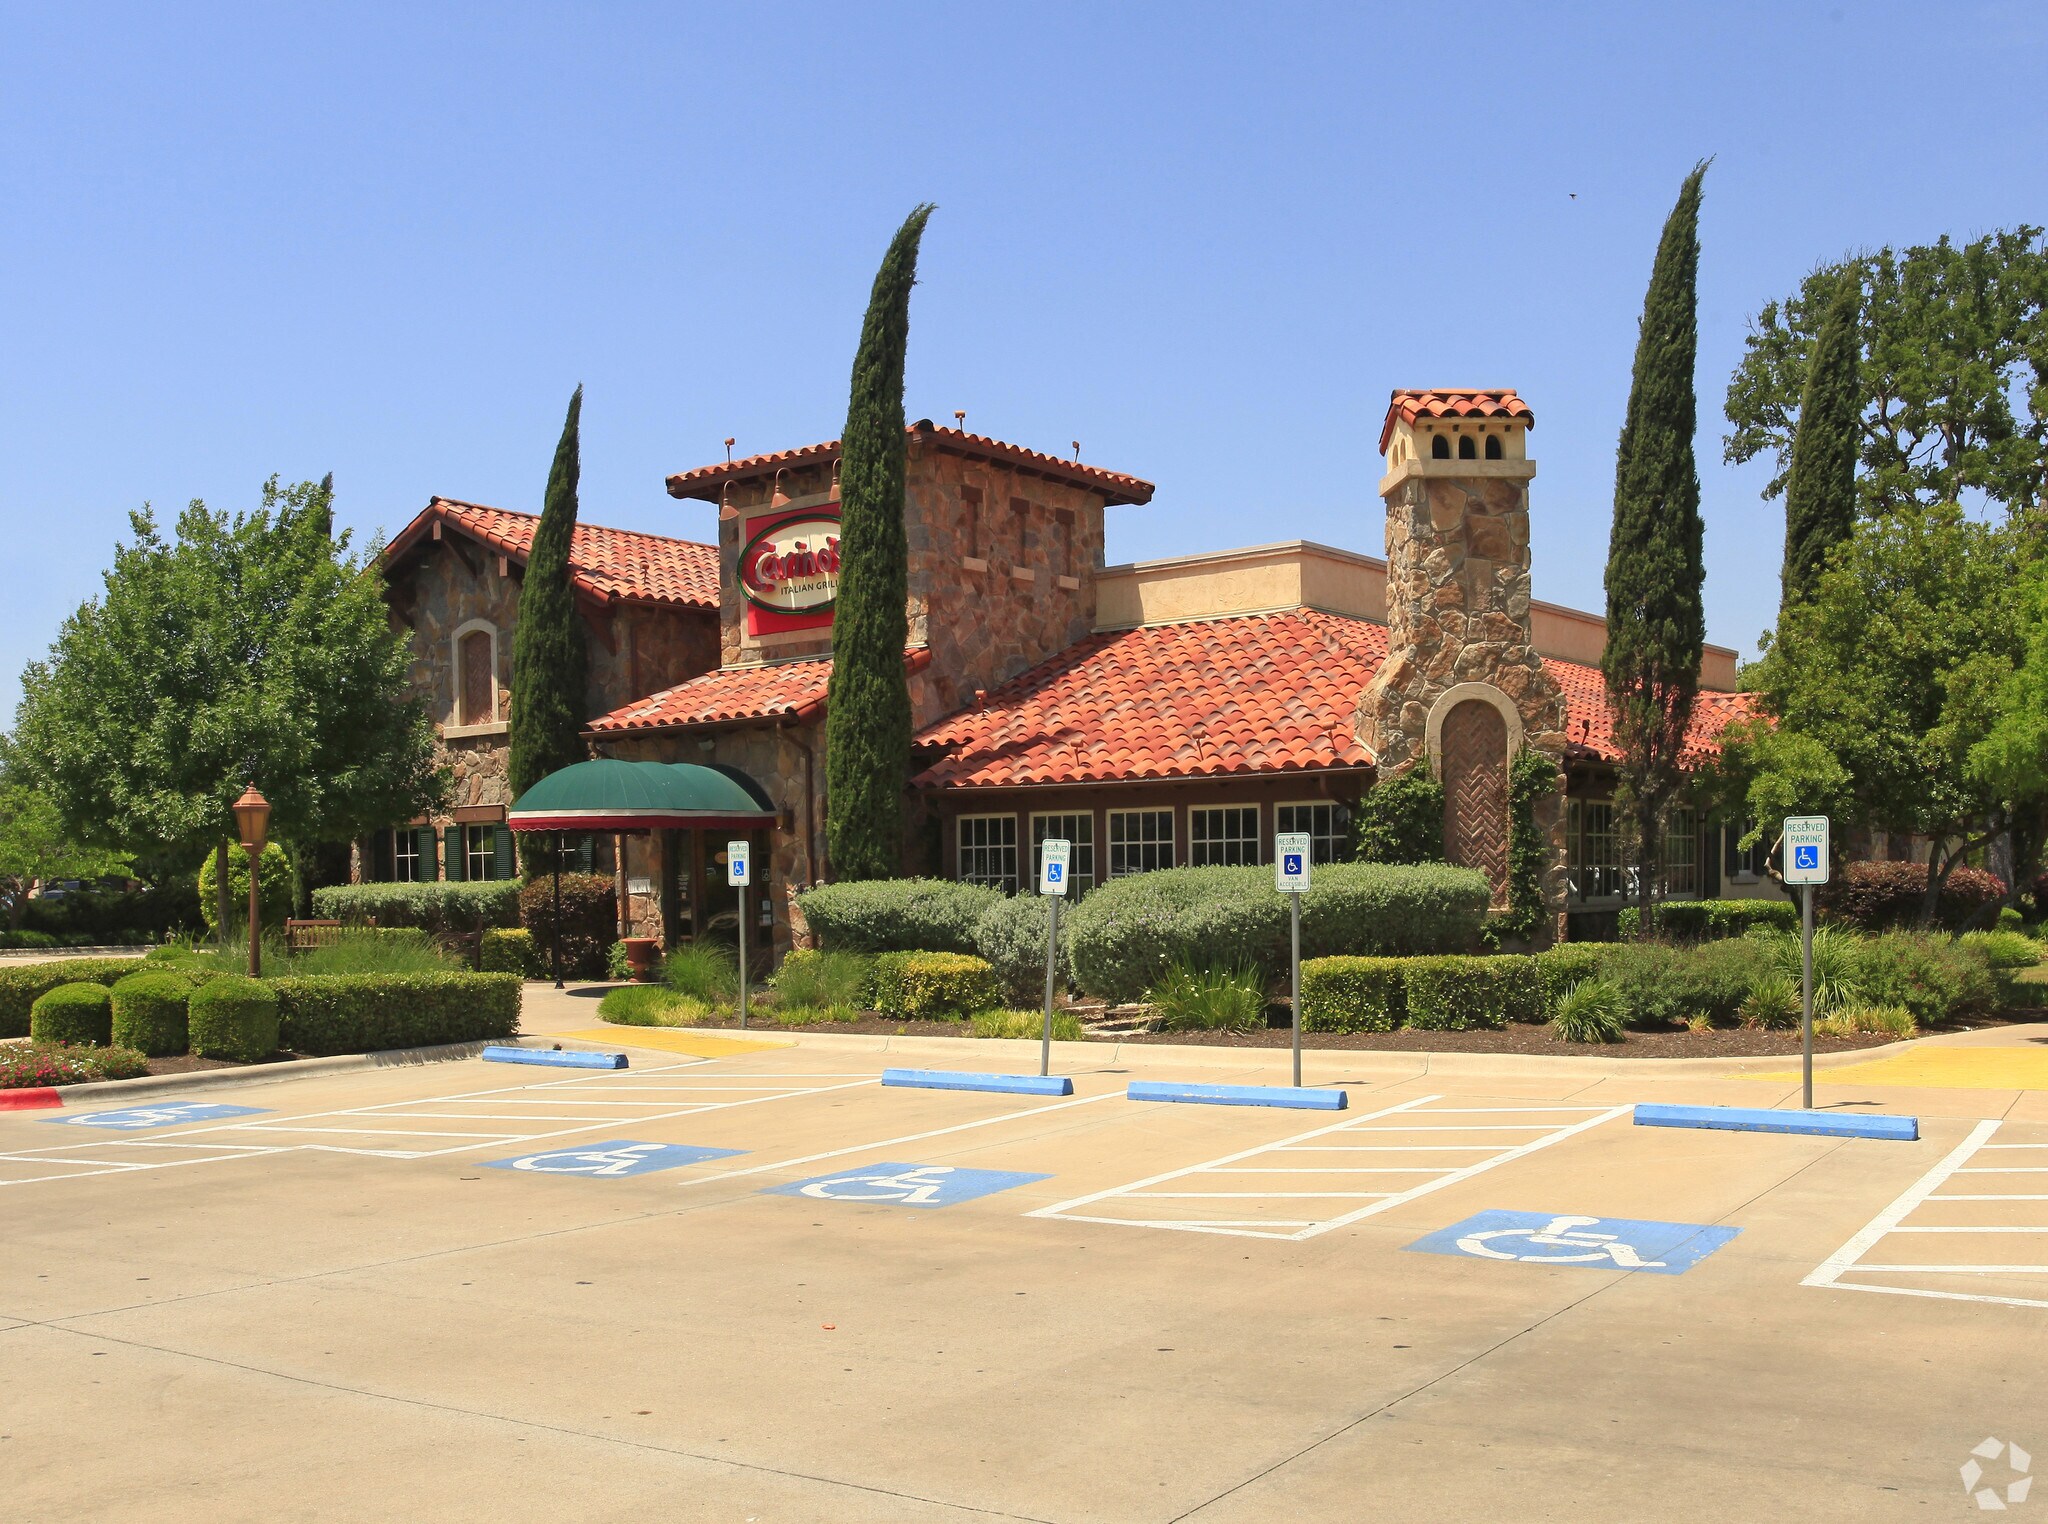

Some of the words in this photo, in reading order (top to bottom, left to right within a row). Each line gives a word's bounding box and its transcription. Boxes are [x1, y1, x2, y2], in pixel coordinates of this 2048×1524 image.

[781, 583, 814, 595] ITALIAN
[1787, 823, 1826, 832] RESERVED
[1278, 838, 1308, 846] RESERVED
[1790, 834, 1823, 843] PARKING
[1280, 846, 1306, 854] PARKING
[1045, 854, 1067, 862] PARKING
